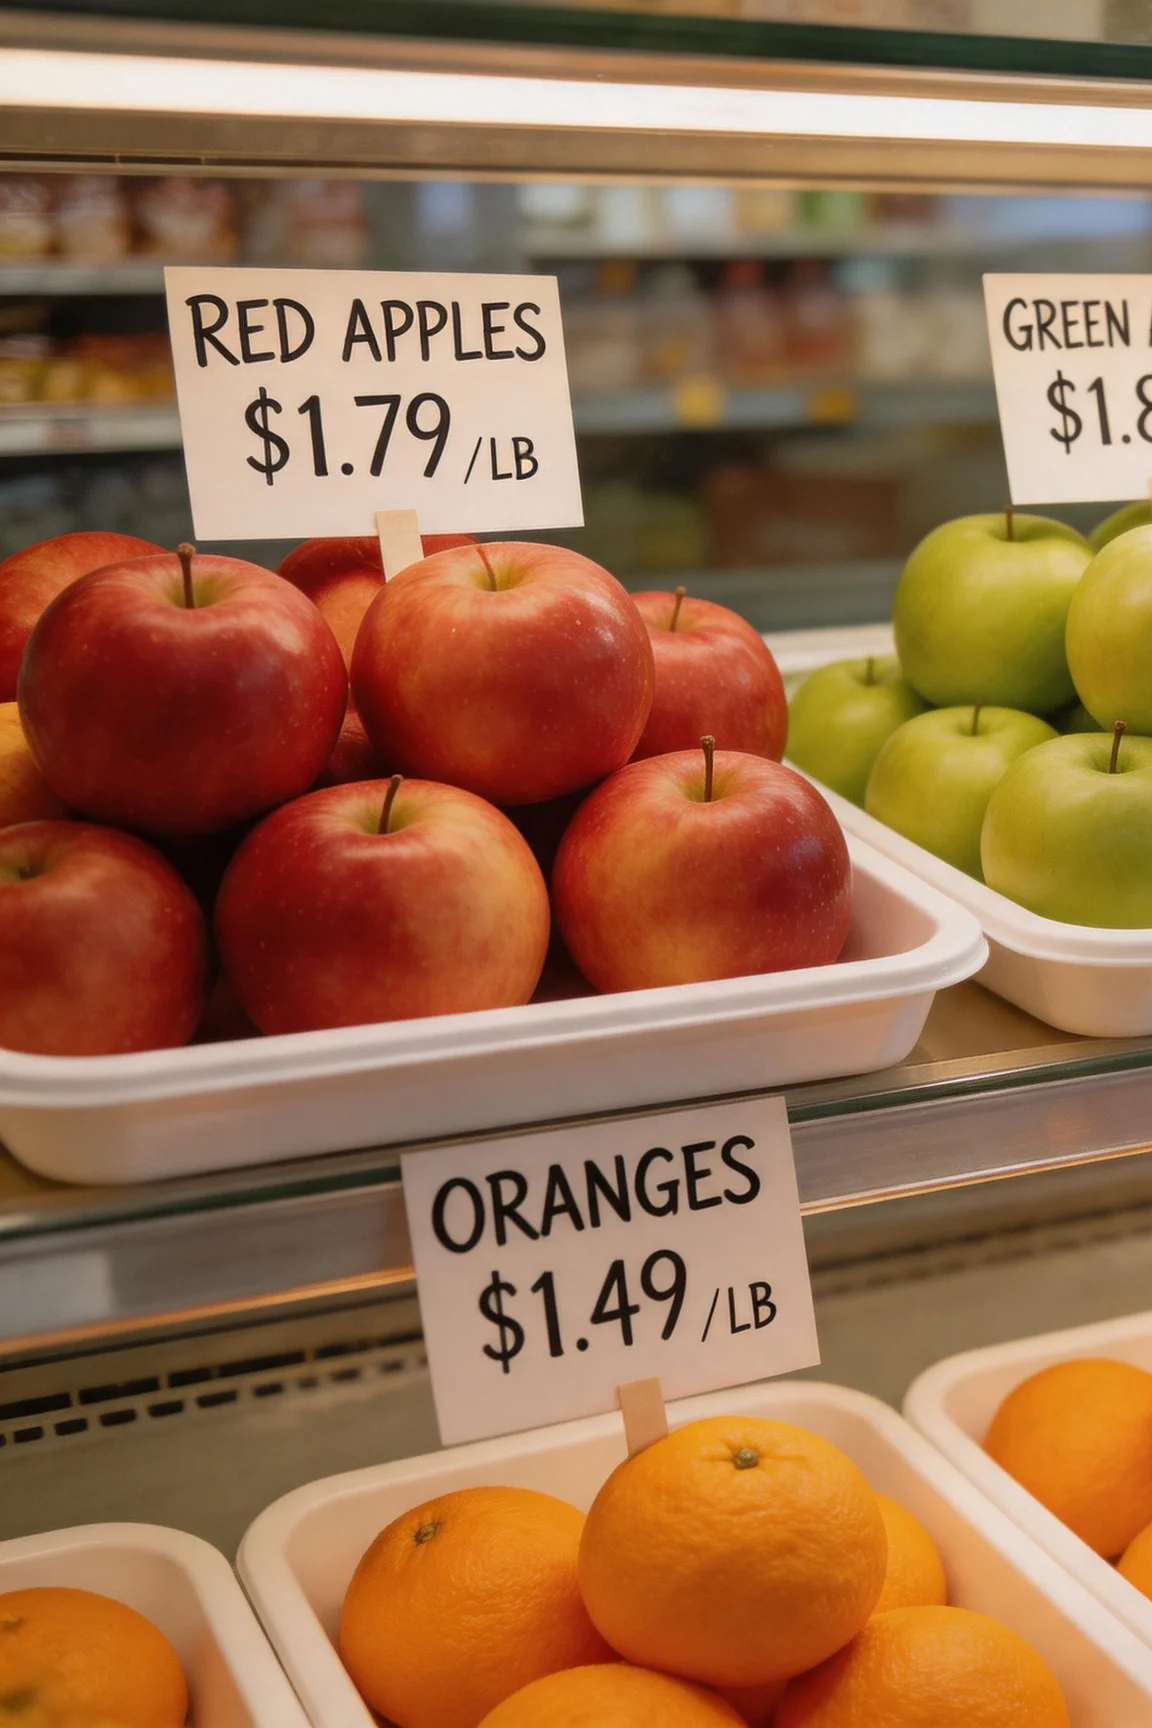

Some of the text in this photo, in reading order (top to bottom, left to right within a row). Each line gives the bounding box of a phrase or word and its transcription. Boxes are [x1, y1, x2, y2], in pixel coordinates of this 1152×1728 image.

[184, 293, 547, 368] RED APPLES
[1002, 297, 1131, 352] GREEN
[244, 386, 539, 487] $1.79 /LB
[430, 1134, 762, 1255] ORANGES
[477, 1248, 777, 1375] $1.49 /LB
